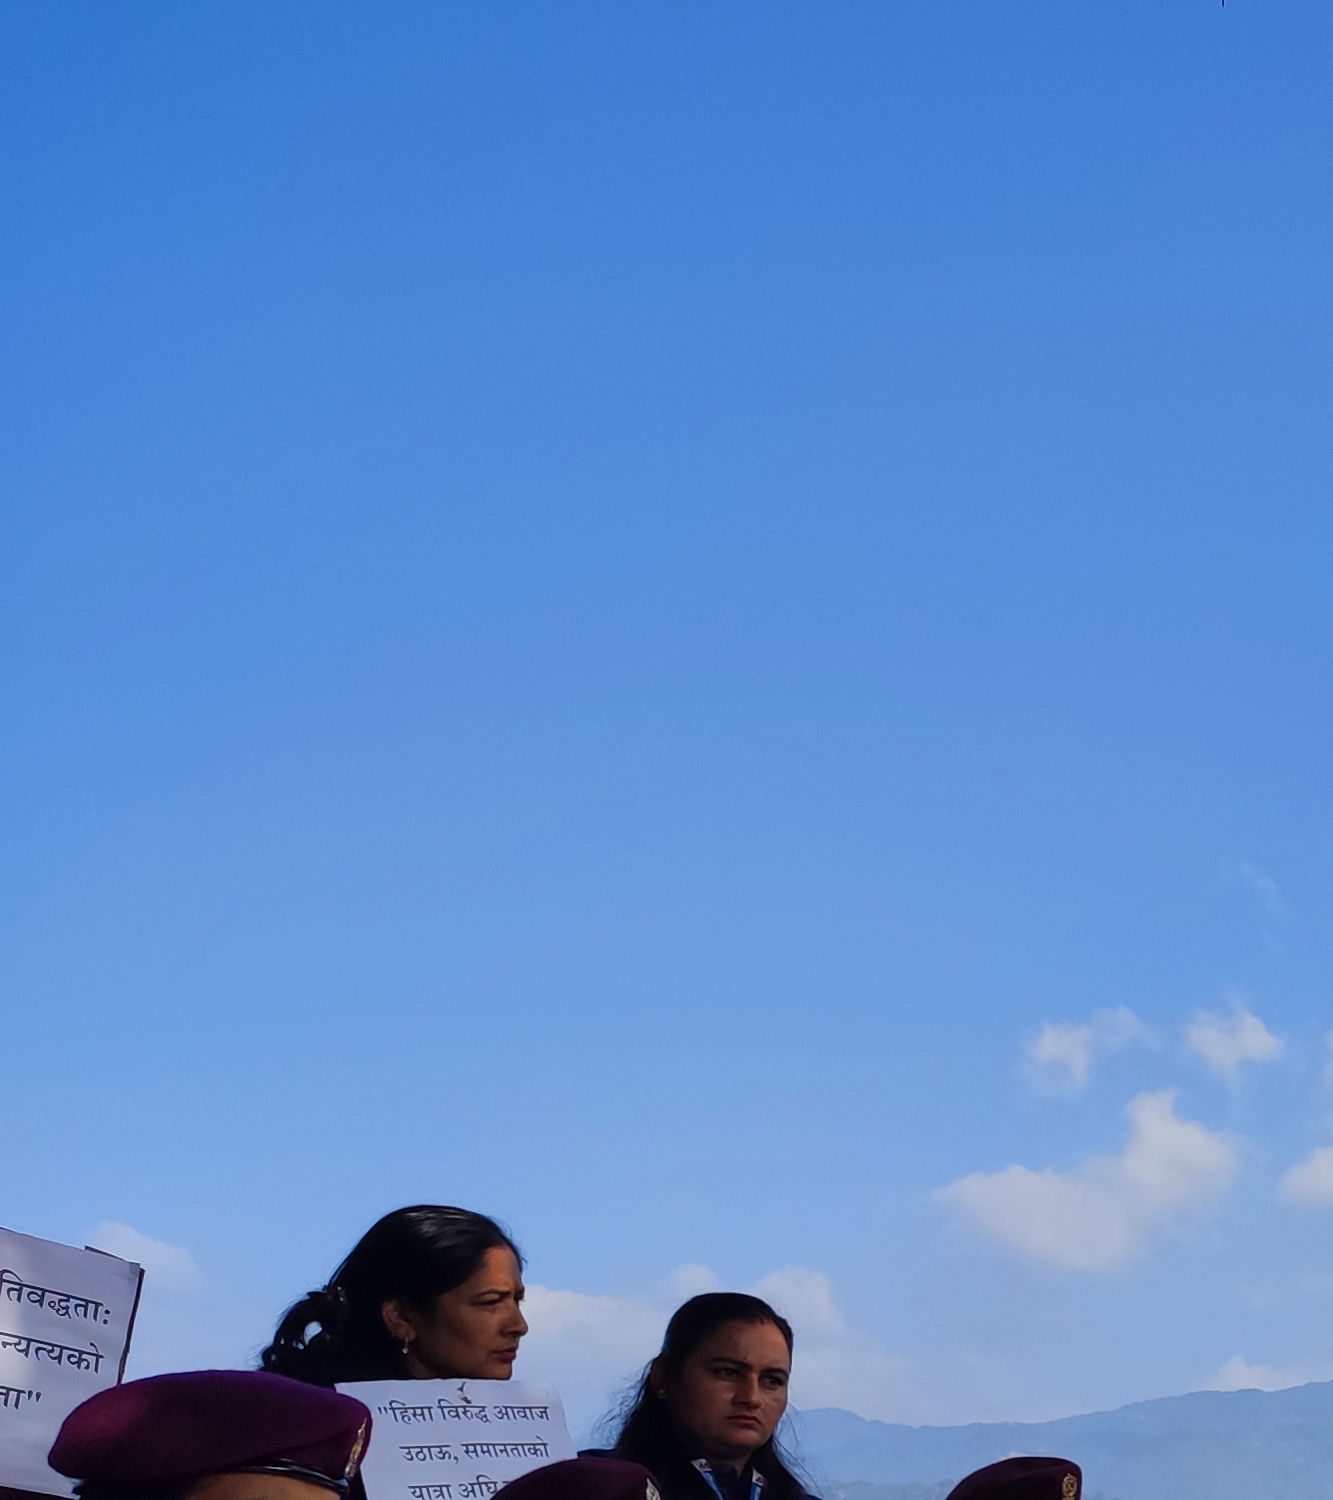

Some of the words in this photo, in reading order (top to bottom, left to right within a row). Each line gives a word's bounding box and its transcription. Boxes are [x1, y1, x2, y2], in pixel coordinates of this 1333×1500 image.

[493, 1405, 550, 1421] आवाज
[399, 1444, 459, 1464] उठाऊ,
[461, 1436, 549, 1459] समानताको
[408, 1484, 452, 1500] यात्रा
